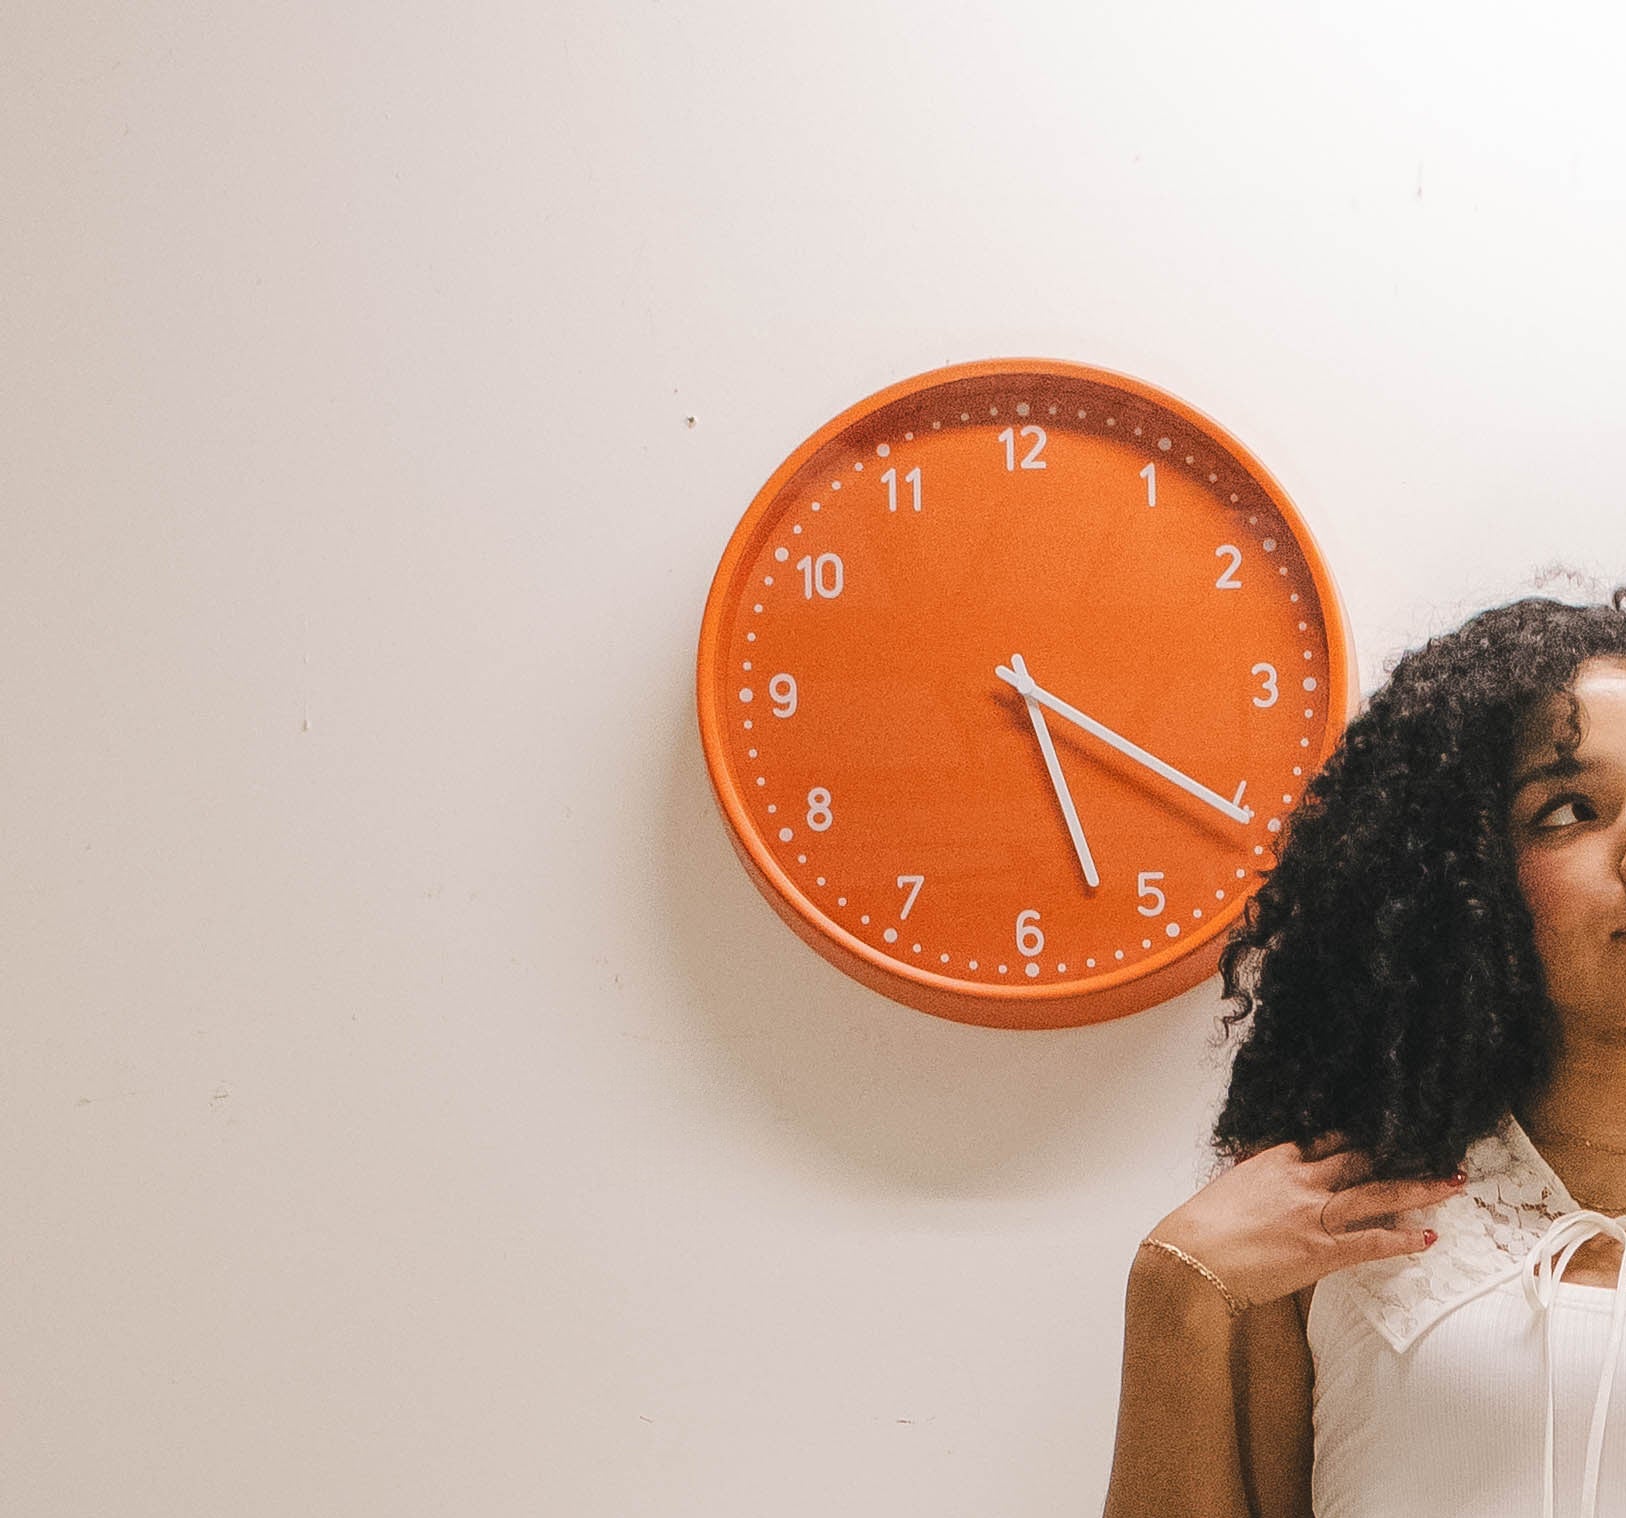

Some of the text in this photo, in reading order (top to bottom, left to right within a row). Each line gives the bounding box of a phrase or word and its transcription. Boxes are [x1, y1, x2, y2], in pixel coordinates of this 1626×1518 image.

[999, 426, 1046, 471] 12
[881, 468, 921, 511] 11
[1140, 464, 1156, 506] 1
[797, 553, 843, 598] 10
[1216, 545, 1241, 588] 2
[770, 674, 797, 717] 9
[1252, 663, 1278, 707] 3
[807, 788, 832, 831] 8
[898, 876, 924, 919] 7
[1138, 872, 1165, 916] 5
[1017, 910, 1044, 956] 6
